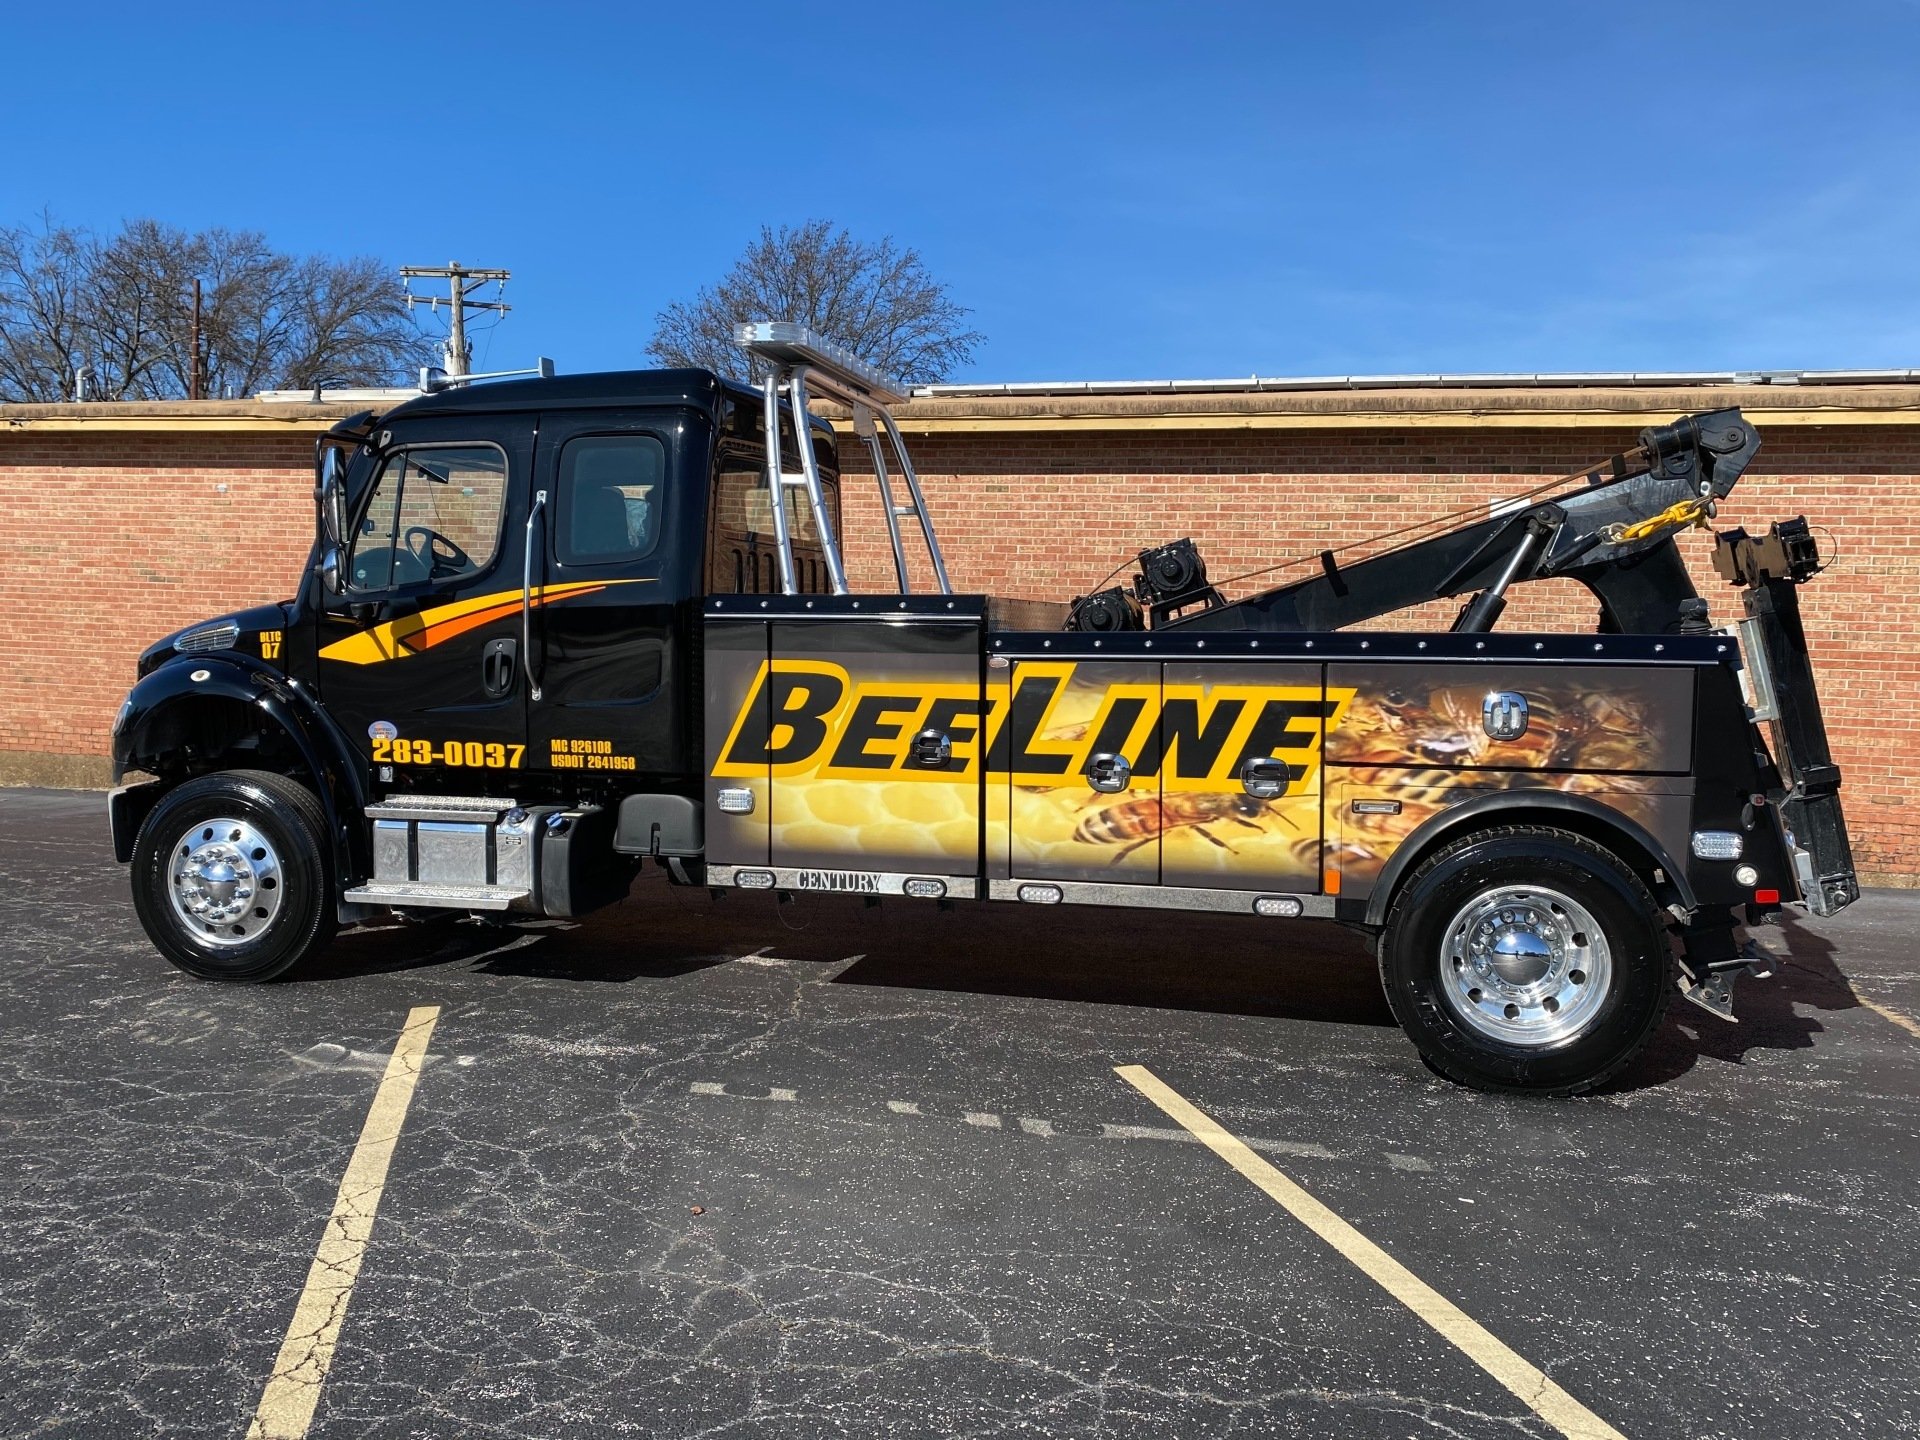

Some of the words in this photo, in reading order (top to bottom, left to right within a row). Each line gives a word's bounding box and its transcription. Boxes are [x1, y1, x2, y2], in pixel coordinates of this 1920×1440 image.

[260, 631, 281, 642] BLTC
[262, 643, 280, 659] 07
[372, 739, 526, 769] 283-0037
[551, 740, 568, 753] MC
[571, 740, 611, 754] 926108
[551, 754, 584, 768] USDOT
[588, 756, 635, 770] 2641958
[797, 870, 881, 893] CENTURY
